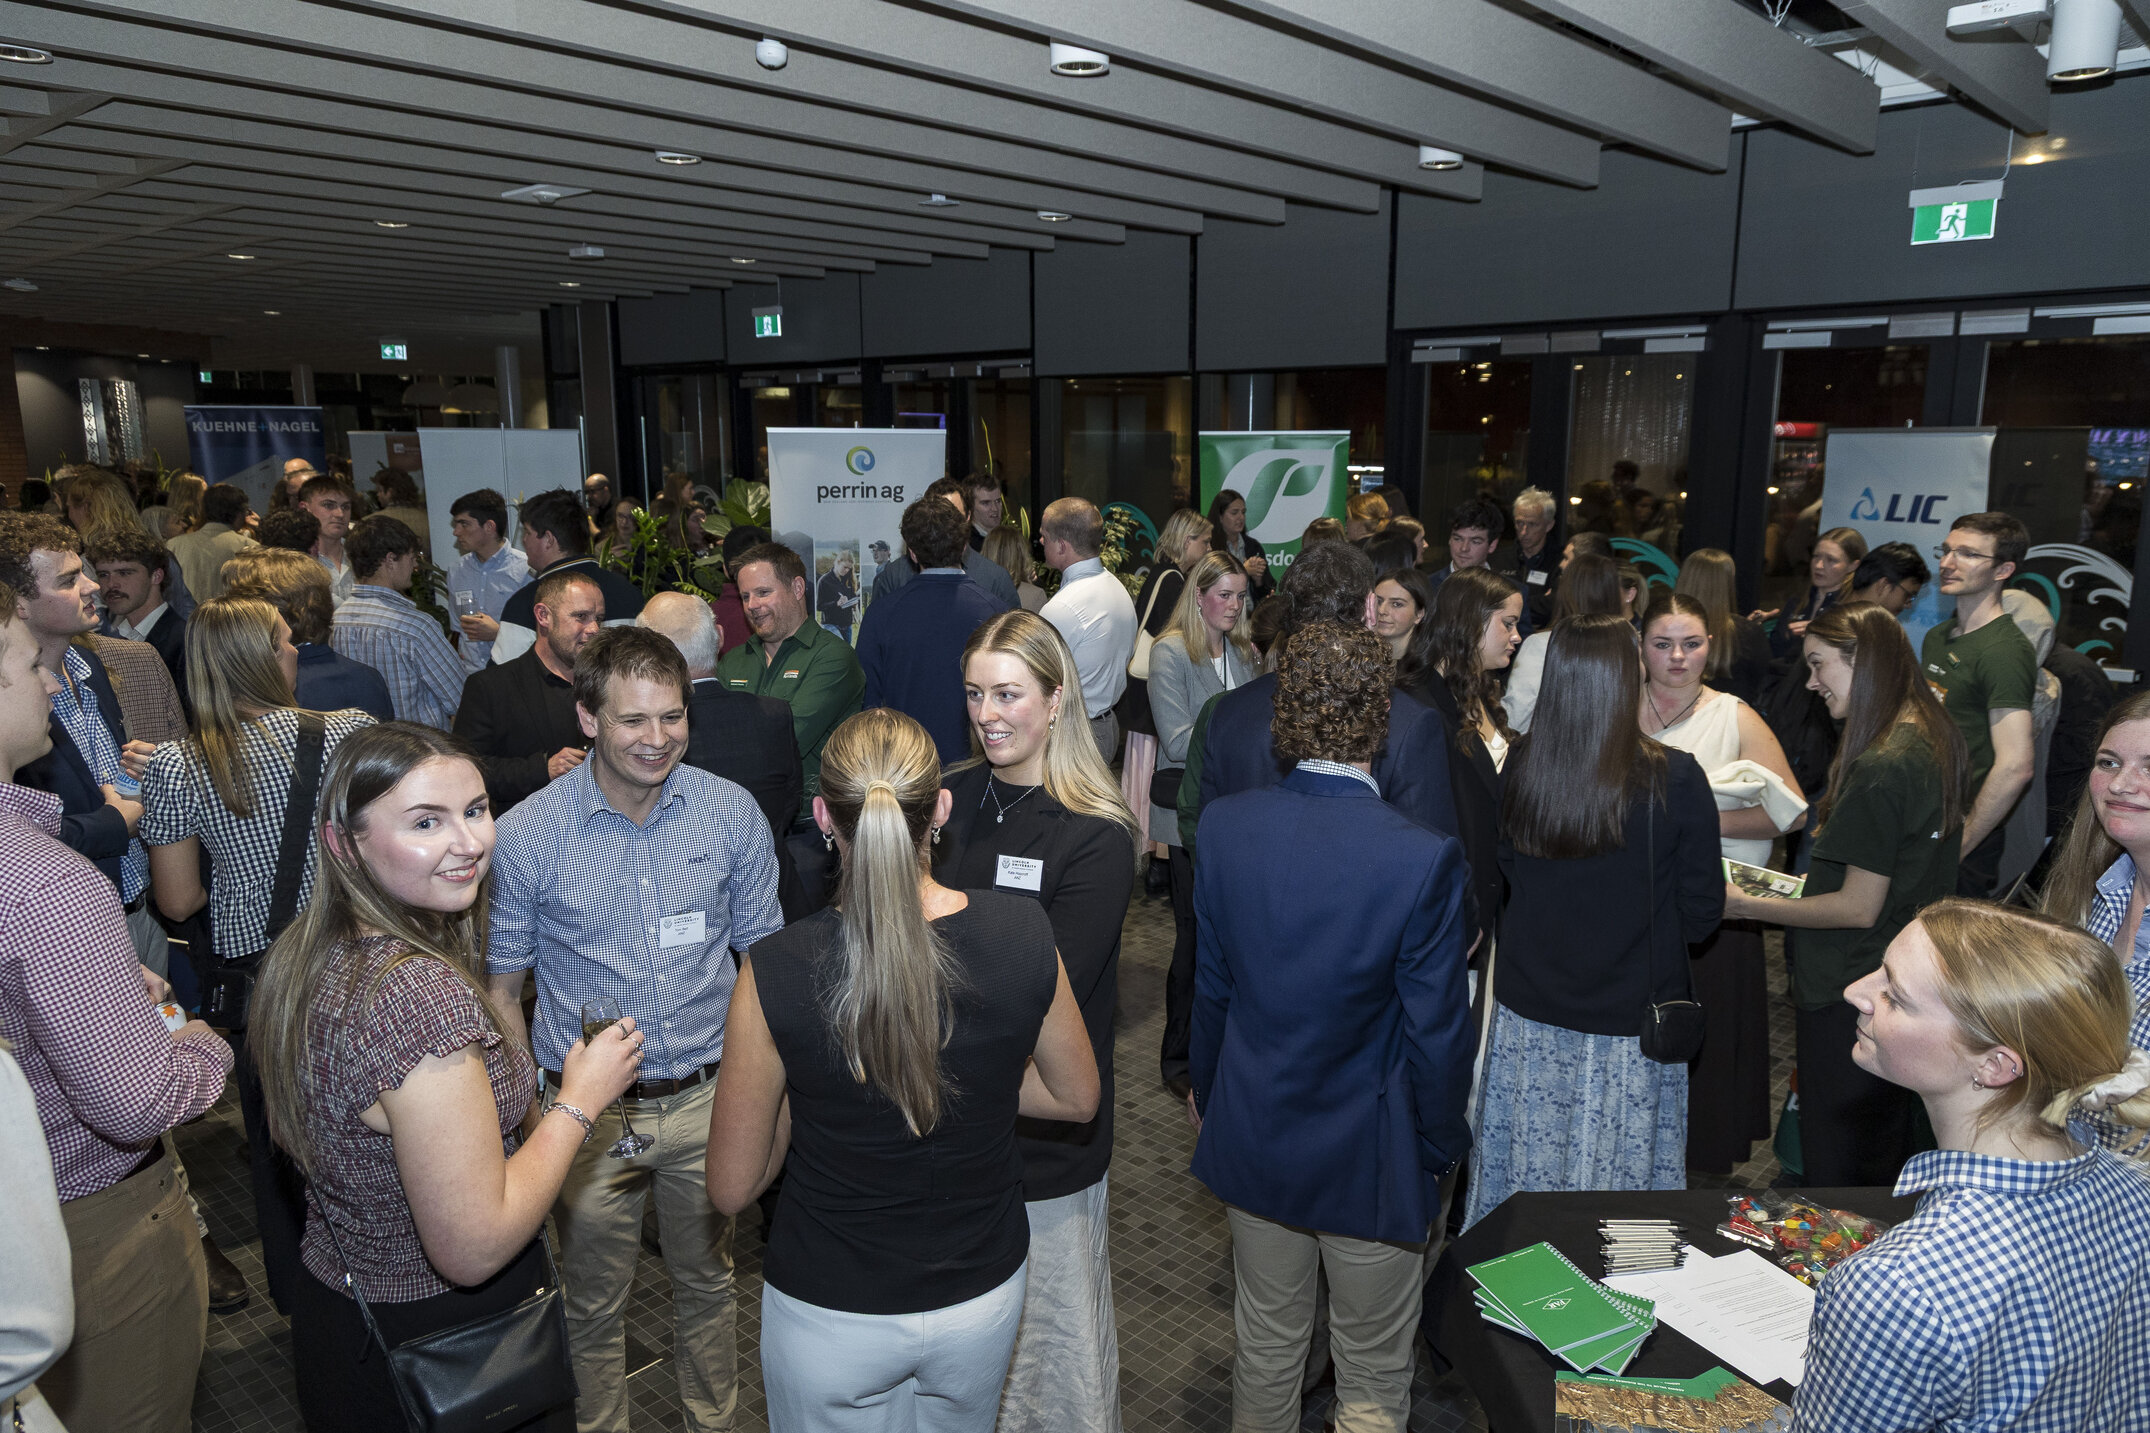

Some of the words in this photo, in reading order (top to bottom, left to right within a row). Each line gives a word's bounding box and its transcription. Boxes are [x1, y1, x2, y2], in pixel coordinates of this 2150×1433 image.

[192, 421, 320, 432] KUEHNE+NAGEL
[816, 481, 877, 504] perrin
[880, 485, 905, 503] ag
[1884, 493, 1949, 524] LIC
[1265, 549, 1296, 567] sdo
